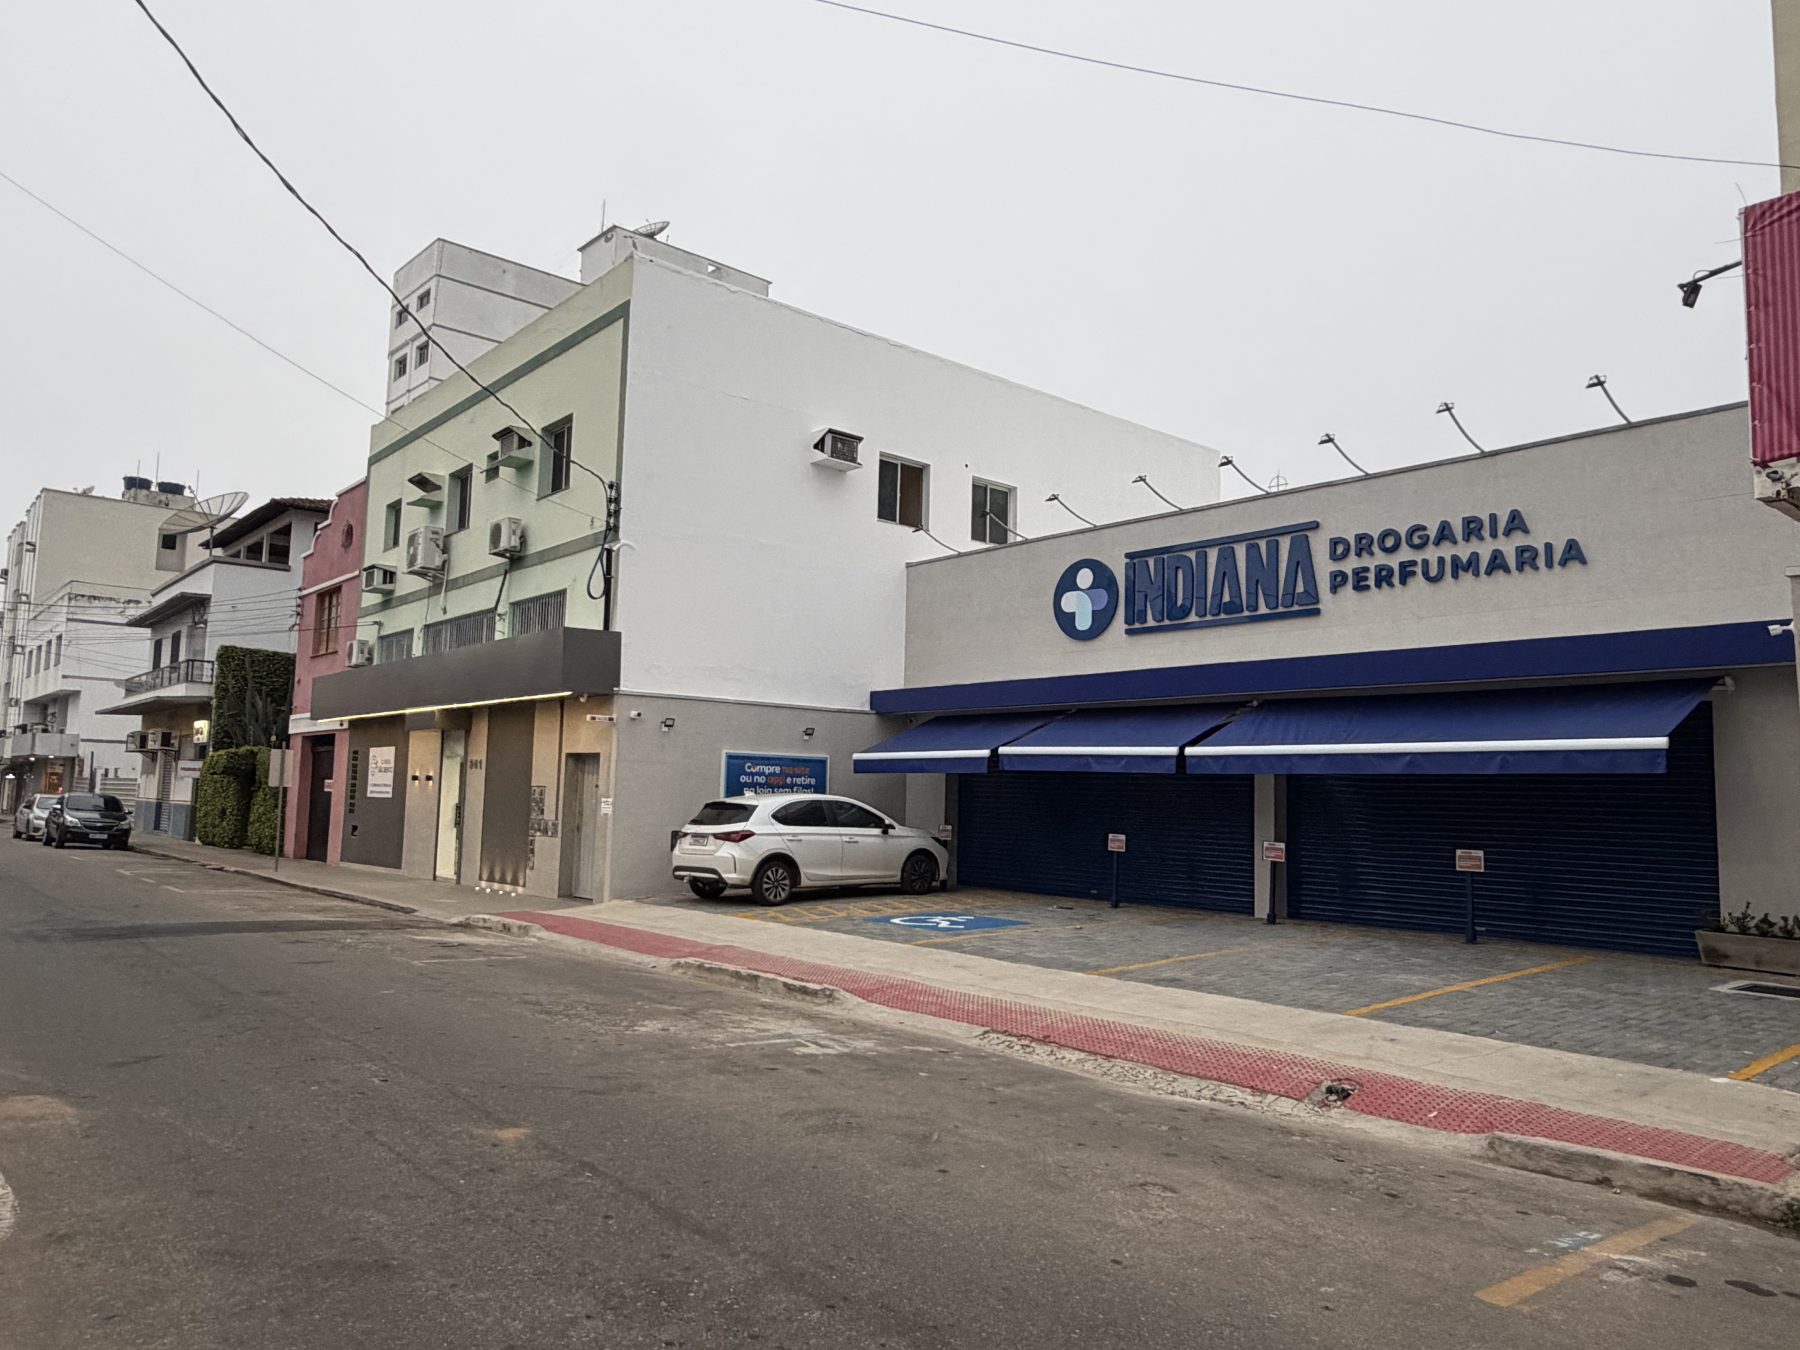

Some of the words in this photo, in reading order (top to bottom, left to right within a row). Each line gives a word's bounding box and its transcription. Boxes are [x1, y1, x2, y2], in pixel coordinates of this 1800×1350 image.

[1329, 508, 1530, 561] DROGARIA
[1124, 534, 1320, 626] INDIANA
[1329, 538, 1588, 594] PERFUMARIA
[740, 775, 752, 783] ou
[754, 775, 766, 784] no
[786, 777, 792, 785] e
[793, 775, 816, 785] retire
[745, 763, 781, 774] Compre
